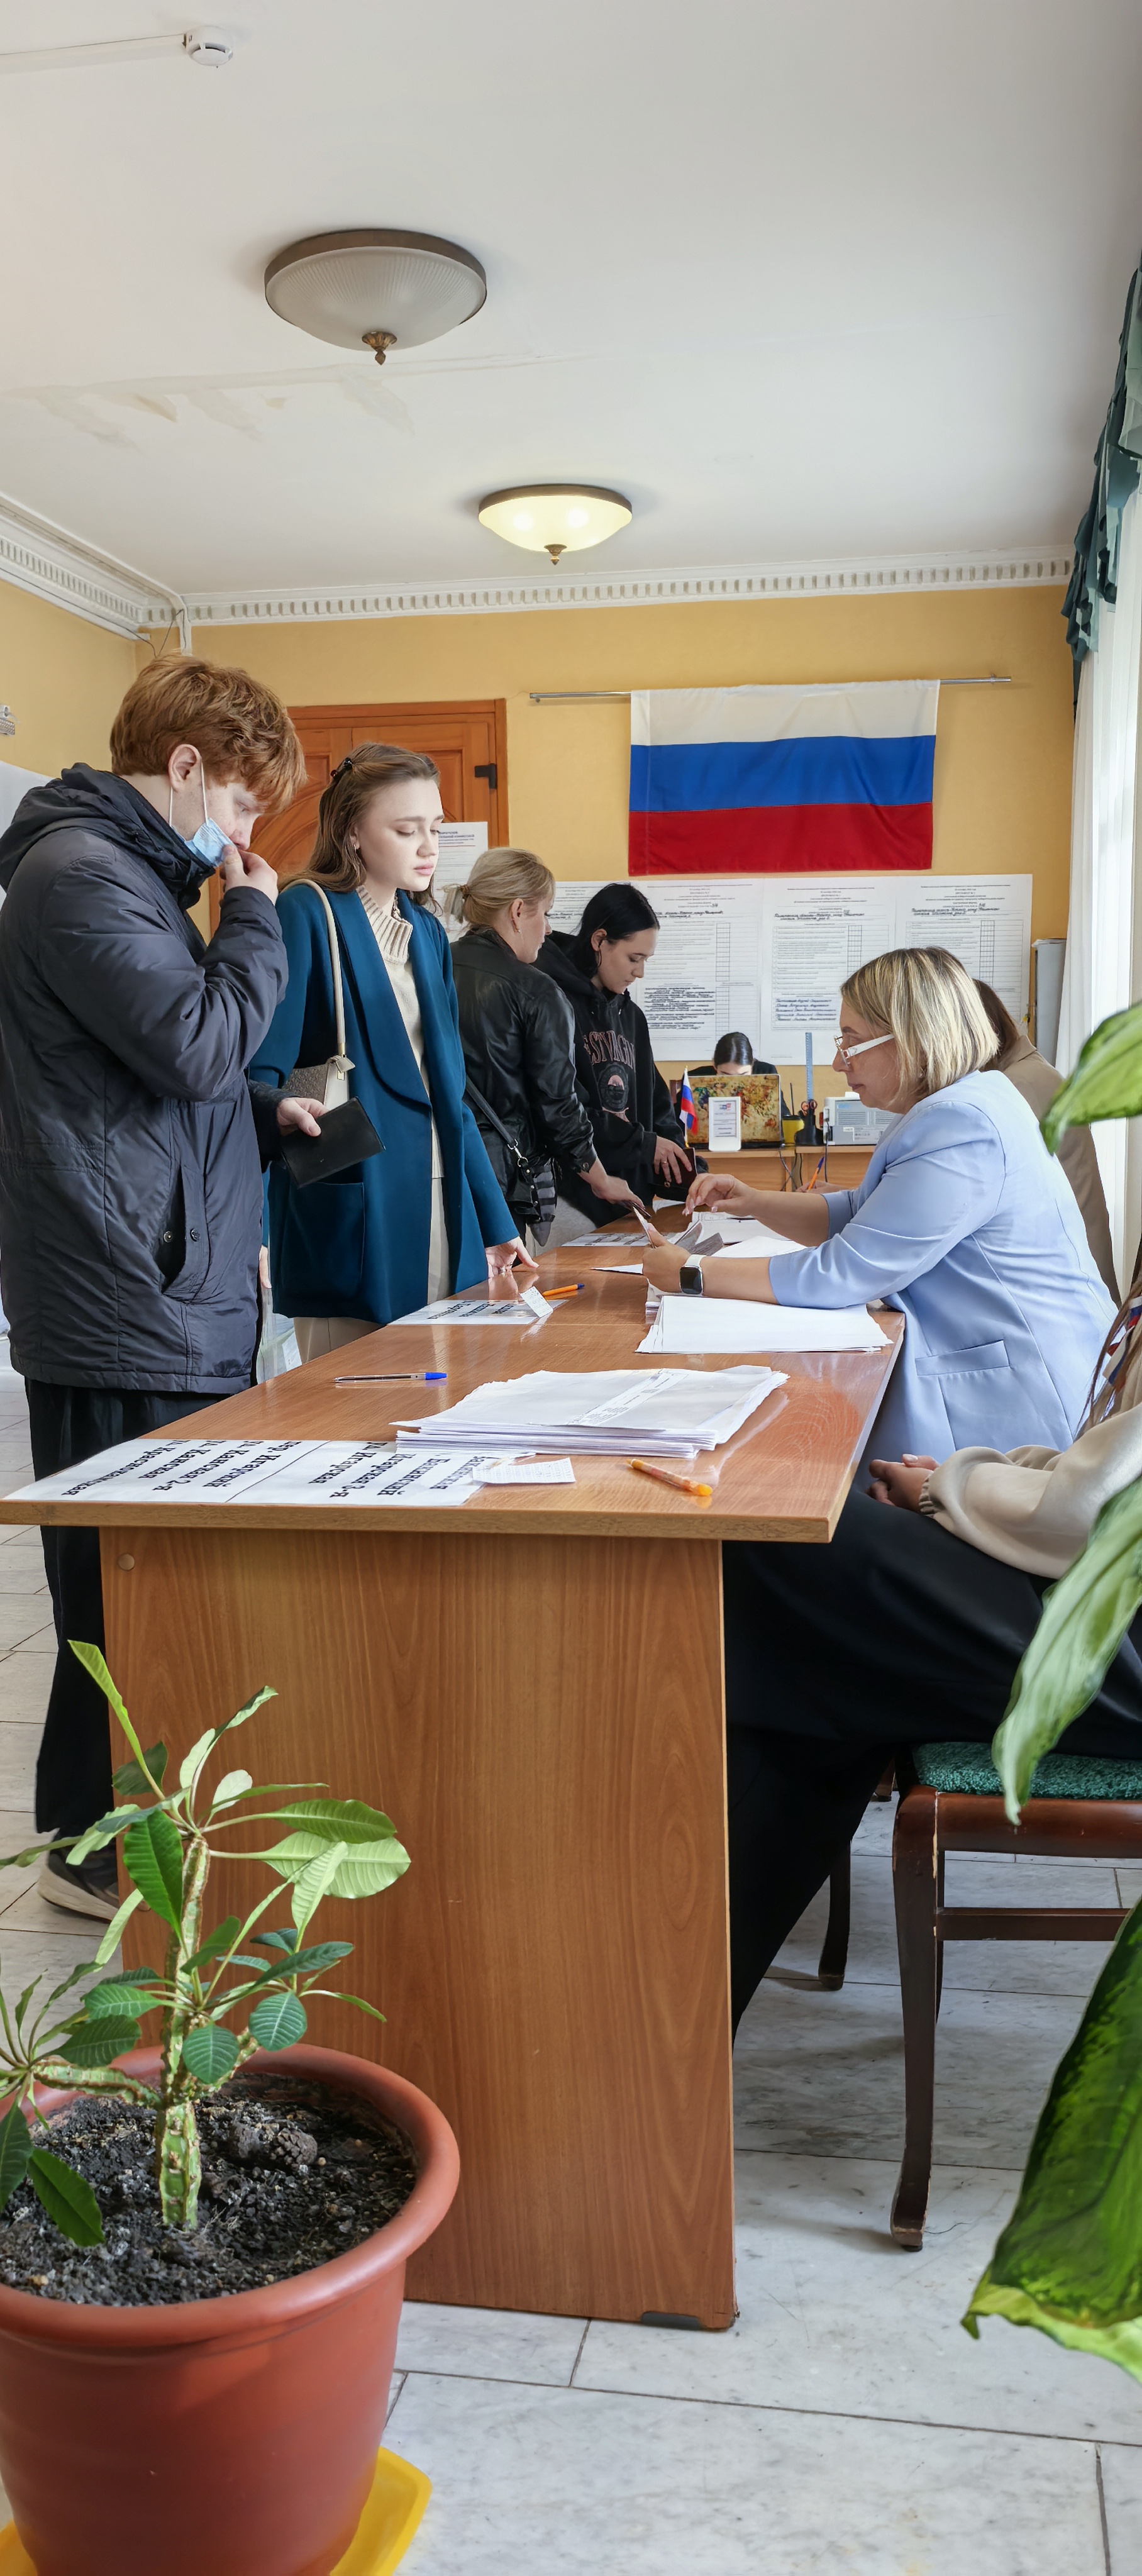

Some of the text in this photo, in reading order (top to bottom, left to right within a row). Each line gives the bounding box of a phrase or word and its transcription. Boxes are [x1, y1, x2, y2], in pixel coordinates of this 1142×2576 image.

[138, 1449, 211, 1479] Канская
[179, 1449, 250, 1479] Канская
[202, 1455, 282, 1487] Игарский
[308, 1452, 377, 1484] Игарская
[329, 1453, 416, 1497] Игарская 3-я
[377, 1458, 451, 1495] Бакинский
[152, 1480, 191, 1491] 2-я
